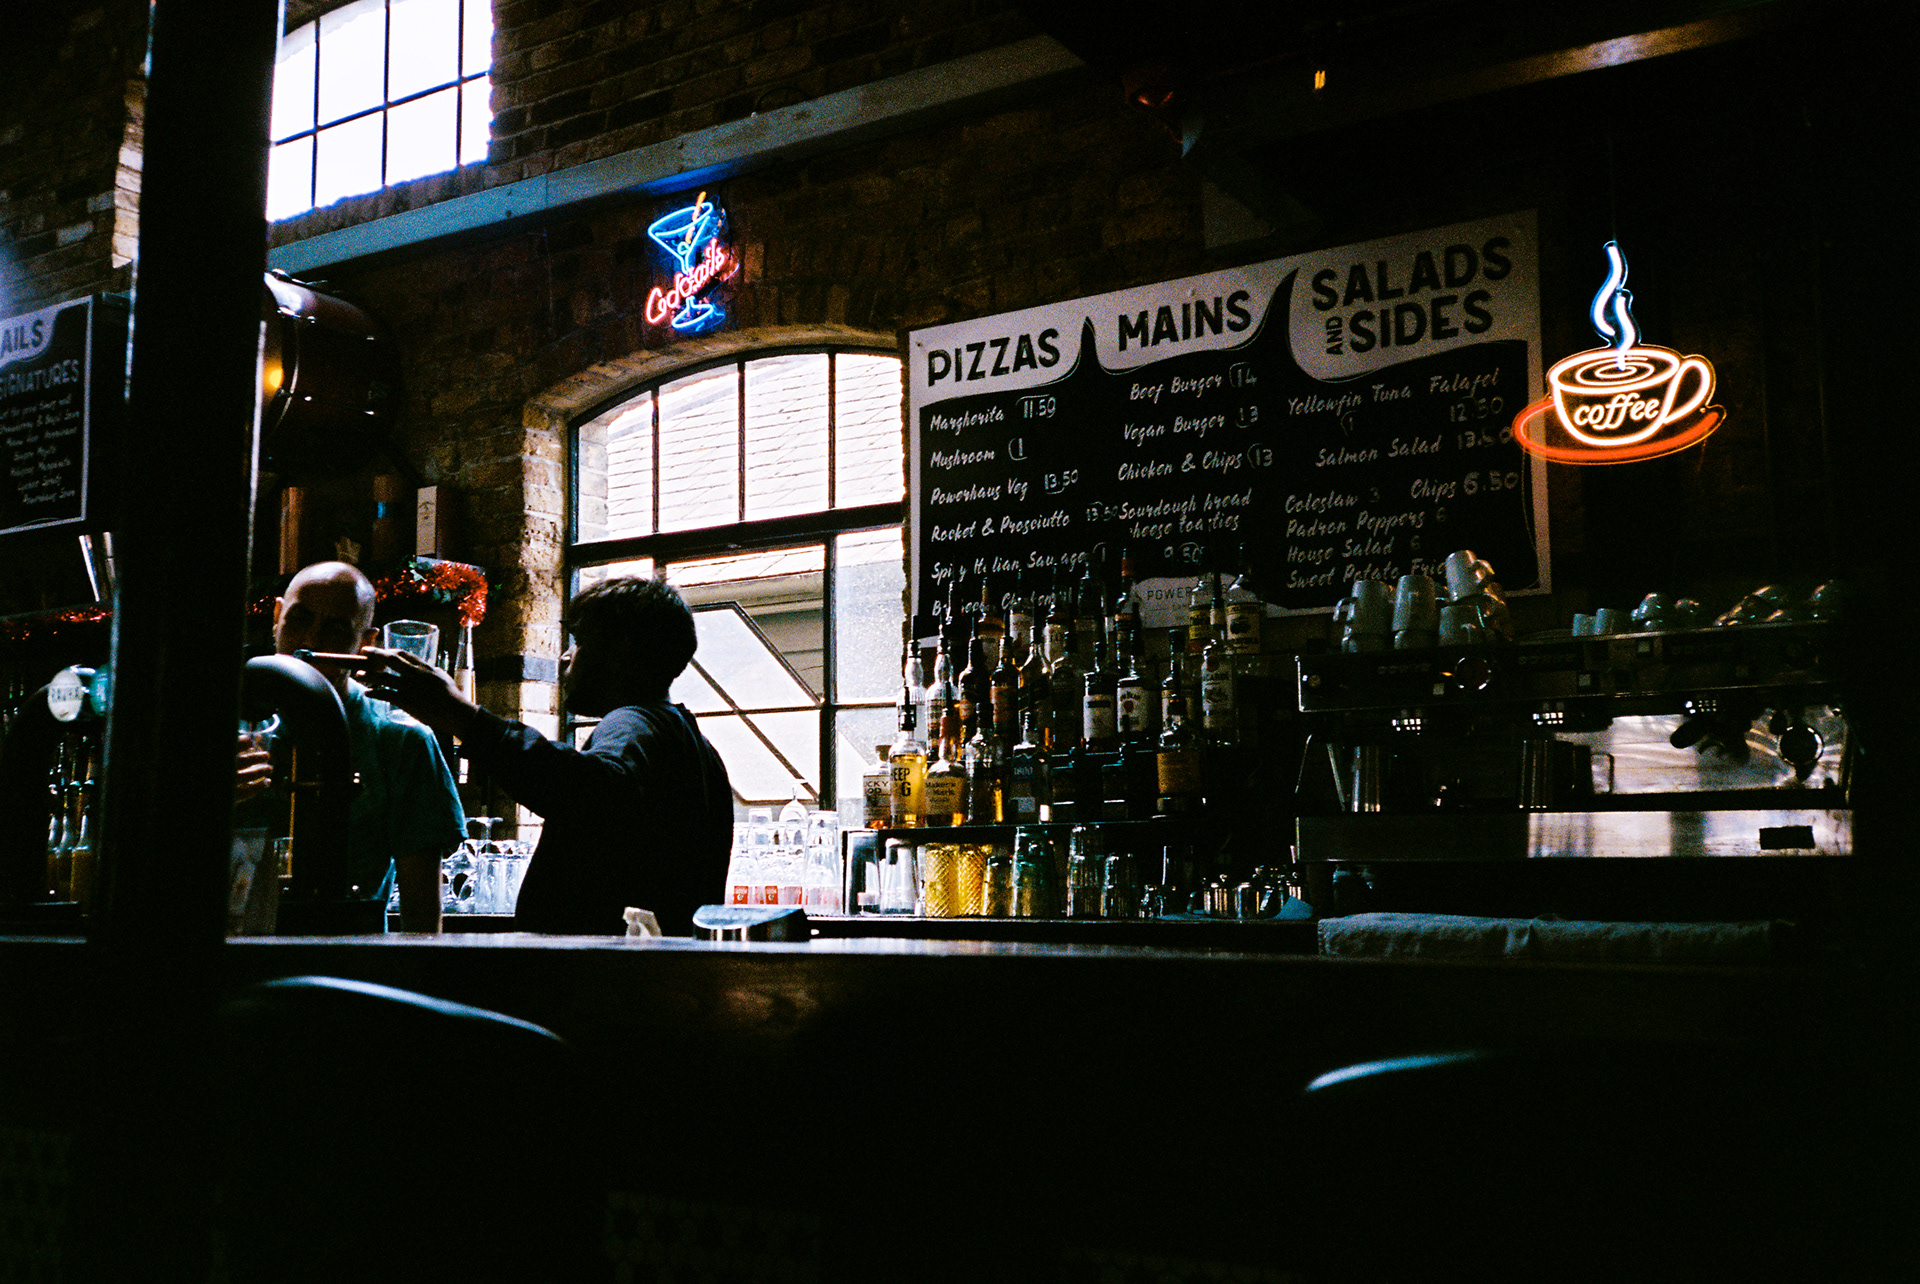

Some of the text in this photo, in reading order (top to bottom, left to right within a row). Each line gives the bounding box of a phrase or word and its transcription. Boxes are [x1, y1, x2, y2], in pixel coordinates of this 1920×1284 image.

[1311, 236, 1512, 312] SALADS
[1118, 290, 1251, 352] MAINS
[1326, 315, 1344, 355] AND
[1349, 290, 1494, 354] SIDES
[927, 328, 1061, 387] PIZZAS
[1130, 383, 1165, 405] Beef
[1171, 374, 1223, 399] Burger
[1429, 367, 1500, 399] Falafel
[1287, 383, 1412, 416] Yellowfin Tuna
[1574, 392, 1660, 431] coffee
[930, 405, 1005, 436] Margherita
[1124, 422, 1166, 448] Vegan
[1173, 414, 1225, 438] Burger
[930, 448, 996, 470] Mushroom
[1117, 459, 1174, 482] Chicken
[1181, 452, 1197, 473] &
[1202, 450, 1244, 475] Chips
[1315, 447, 1379, 468] Salmon
[1387, 435, 1443, 458] Salad
[930, 483, 1001, 505] Powerhaus
[1007, 477, 1029, 502] Veg
[1284, 490, 1359, 514] Coleslaw
[1410, 478, 1457, 503] Chips
[1119, 494, 1197, 520] Sourdough
[930, 520, 977, 543] Rocket
[981, 517, 995, 537] &
[1000, 509, 1071, 535] Prosciutto
[1286, 518, 1348, 538] Padron
[1356, 509, 1426, 537] Peppers
[1286, 545, 1334, 566] House
[1342, 536, 1395, 558] Salad
[931, 562, 967, 587] Spiy
[1286, 566, 1336, 589] Sweet
[1410, 557, 1447, 577] Frie
